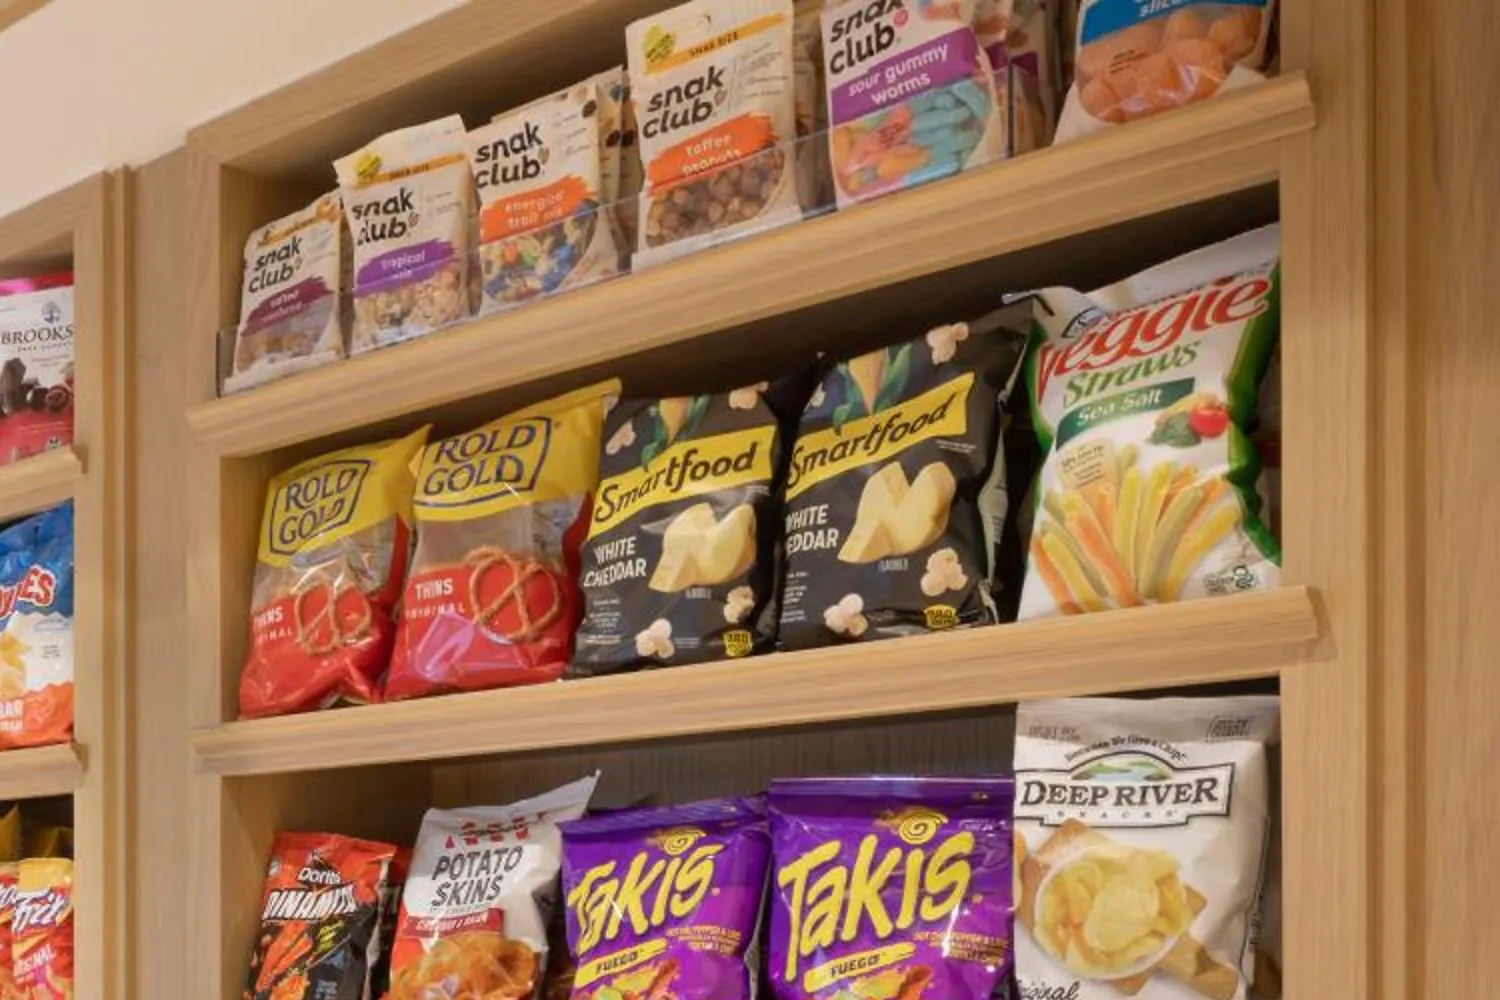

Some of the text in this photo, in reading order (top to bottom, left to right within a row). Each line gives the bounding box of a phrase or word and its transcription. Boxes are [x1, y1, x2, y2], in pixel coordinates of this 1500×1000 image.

[829, 22, 896, 75] club
[848, 43, 949, 97] sour gummy
[648, 66, 726, 113] snak
[871, 73, 931, 105] worms
[643, 98, 713, 139] club
[475, 121, 543, 163] snak
[474, 156, 541, 189] club
[352, 187, 415, 218] snak
[254, 236, 302, 271] snak
[249, 262, 294, 293] club
[1, 323, 74, 346] BROOKS
[1038, 277, 1272, 407] Veggie
[1064, 342, 1200, 412] Straws
[1077, 389, 1162, 427] Sea Salt
[433, 424, 537, 465] ROLD
[786, 393, 957, 490] Smartfood
[285, 467, 359, 512] ROLD
[423, 455, 524, 496] GOLD
[594, 441, 757, 524] Smartfood
[279, 498, 346, 546] GOLD
[593, 535, 638, 566] WHITE
[786, 527, 839, 557] EDDAR
[415, 578, 454, 600] THINS
[583, 558, 647, 587] CHEDDAR
[1020, 777, 1219, 807] DEEP RIVER
[431, 845, 523, 881] POTATO
[431, 875, 504, 907] SKINS
[596, 951, 639, 974] FUEGO
[831, 953, 880, 977] FUEGO
